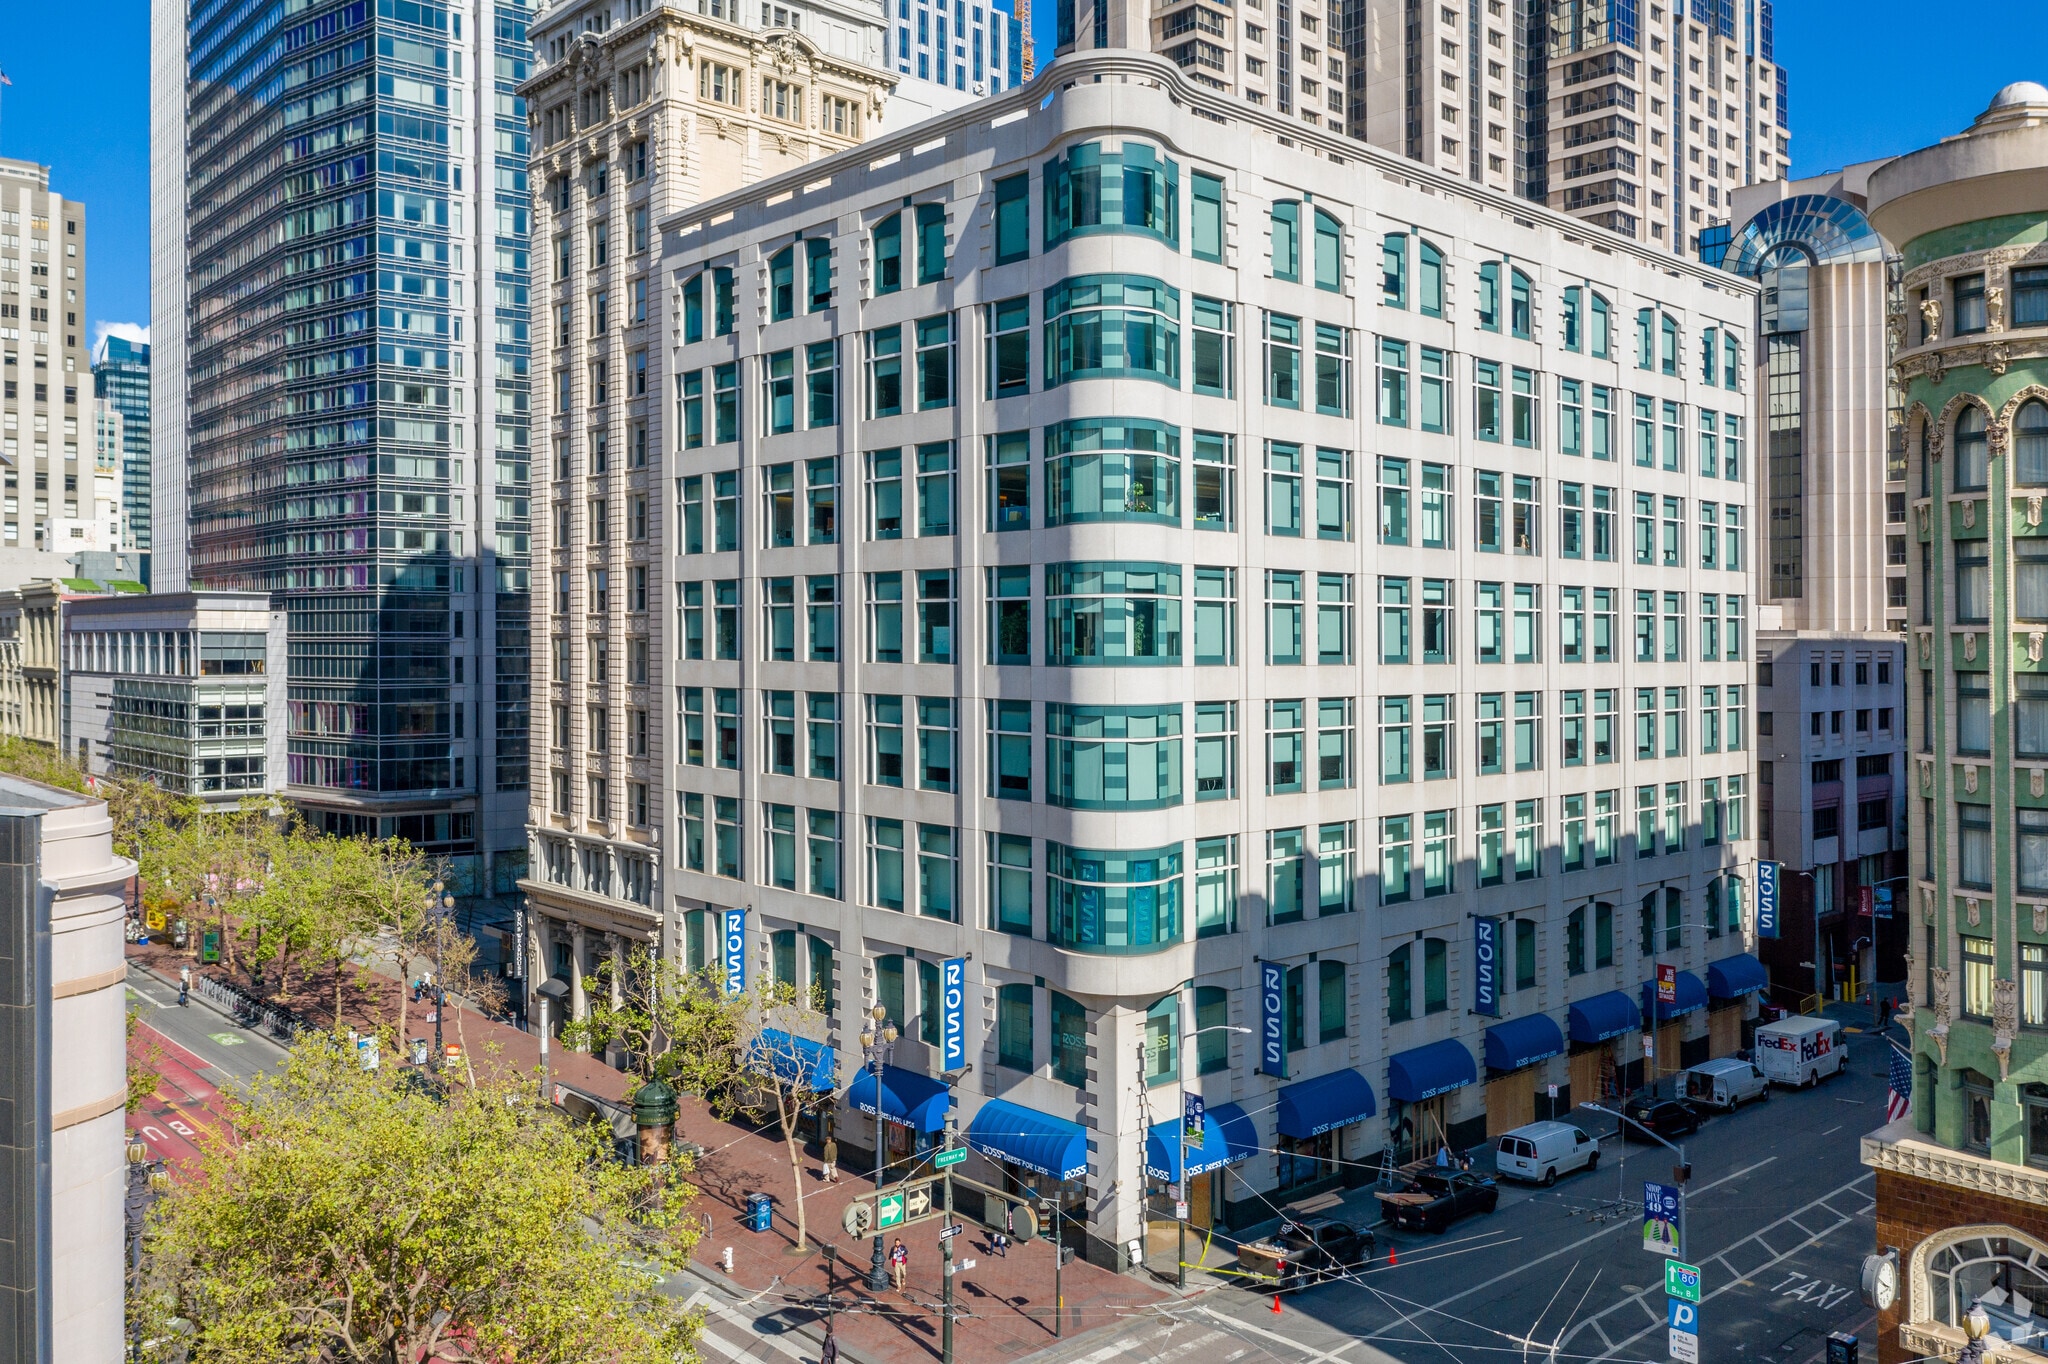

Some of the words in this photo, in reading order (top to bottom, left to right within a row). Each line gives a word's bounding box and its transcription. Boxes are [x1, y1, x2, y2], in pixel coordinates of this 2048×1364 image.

[1759, 864, 1774, 929] ROSS
[728, 914, 742, 994] ROSS
[1478, 922, 1493, 1004] ROSS
[946, 965, 961, 1058] ROSS
[1265, 968, 1281, 1064] ROSS
[1062, 1032, 1087, 1049] ROSS
[1757, 1034, 1798, 1052] FedEx
[1801, 1031, 1830, 1062] FedEx
[1516, 1056, 1529, 1068] ROSS
[1421, 1087, 1437, 1099] ROSS
[860, 1102, 877, 1115] ROSS
[903, 1119, 915, 1128] LESS
[1312, 1123, 1329, 1136] ROSS
[1330, 1119, 1345, 1131] DRESS
[1345, 1116, 1355, 1126] FOR
[1355, 1113, 1367, 1123] LESS
[937, 1153, 958, 1164] FREEWAY
[982, 1144, 1002, 1159] ROSS
[1003, 1153, 1021, 1166] DRESS
[1021, 1159, 1033, 1170] FOR
[1034, 1165, 1049, 1176] LESS
[1187, 1164, 1203, 1177] OSS
[1204, 1160, 1223, 1172] DRESS
[1223, 1156, 1235, 1168] FOR
[1235, 1152, 1248, 1162] LESS
[1064, 1164, 1087, 1180] ROSS
[1148, 1165, 1170, 1181] ROSS
[1649, 1202, 1662, 1213] 49
[1681, 1273, 1695, 1285] 80
[1770, 1271, 1854, 1310] TAXI
[1671, 1285, 1683, 1296] Bay
[1685, 1290, 1694, 1298] Br
[1673, 1303, 1694, 1327] P
